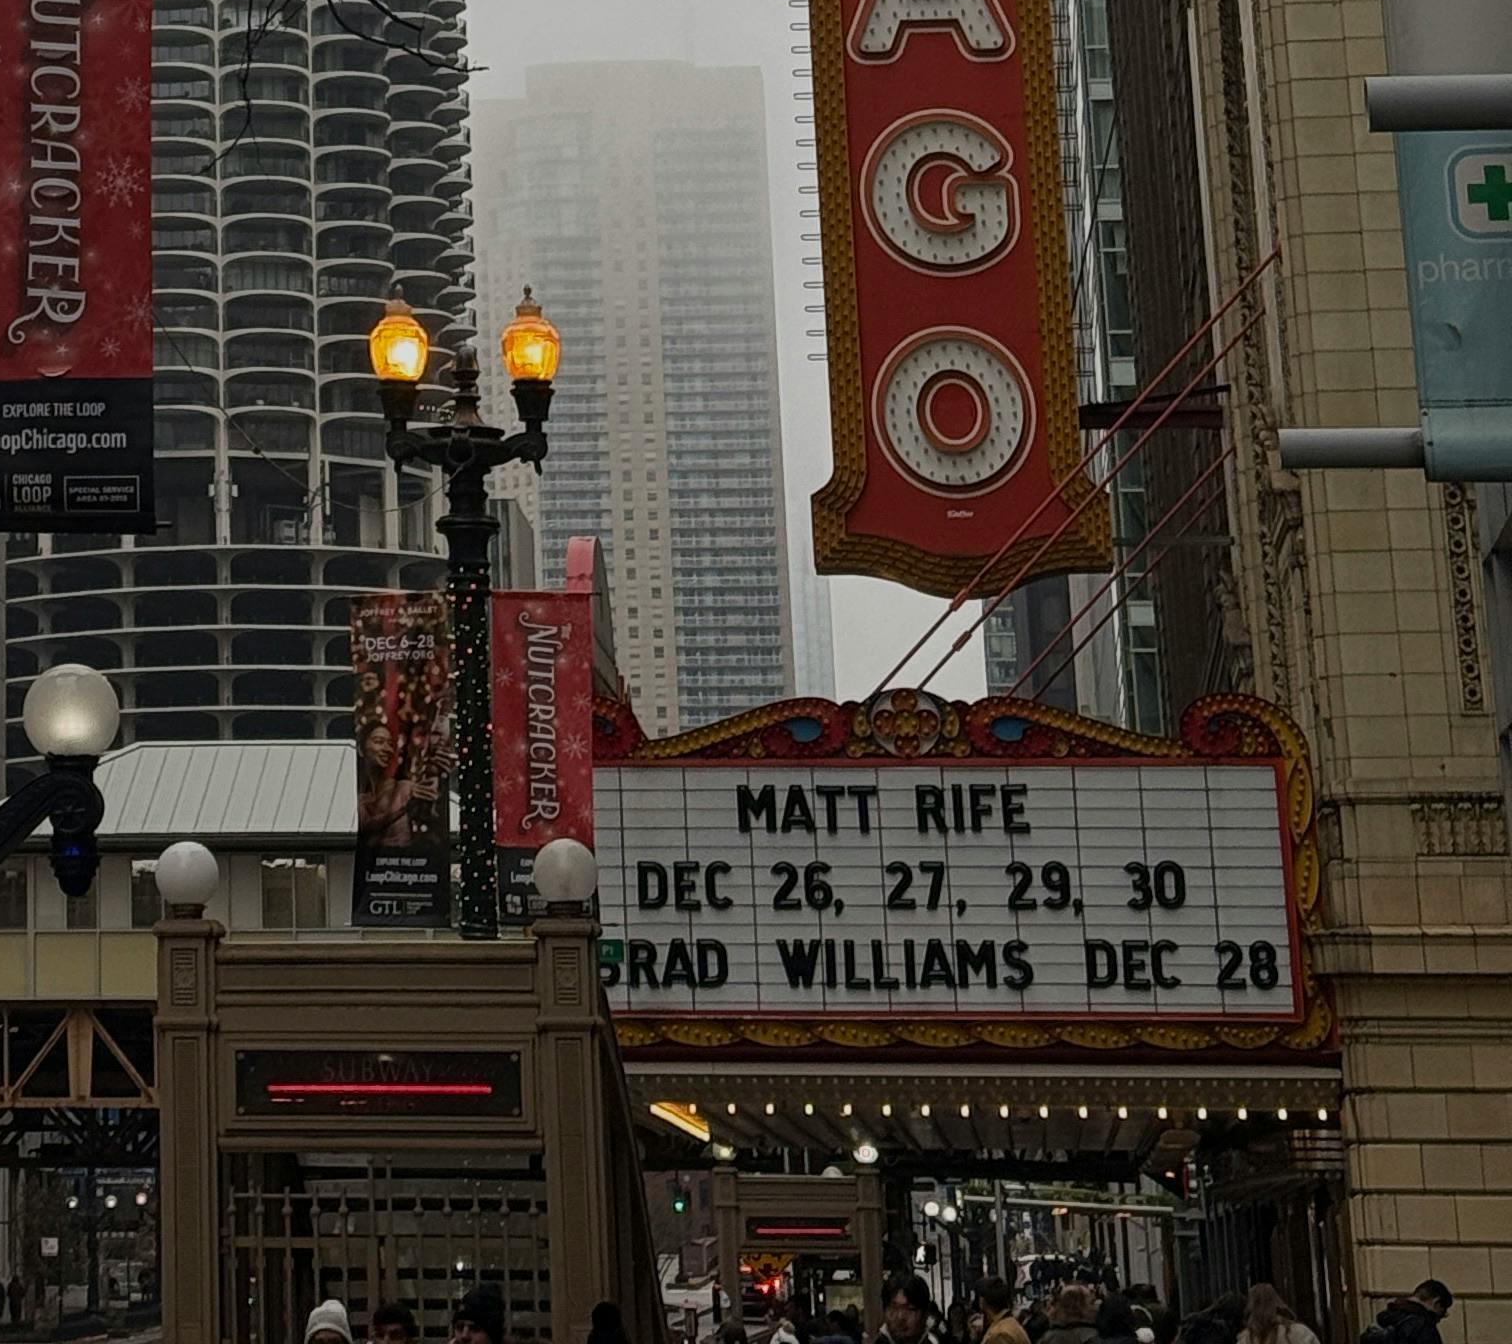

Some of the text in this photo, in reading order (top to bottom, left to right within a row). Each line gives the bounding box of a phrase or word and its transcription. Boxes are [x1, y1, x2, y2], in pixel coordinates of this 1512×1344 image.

[2, 401, 106, 418] EXPLORE THE LOOP
[12, 473, 52, 485] CHICAGO
[13, 486, 52, 504] LOOP
[366, 635, 397, 650] DEC
[518, 610, 564, 831] NUTCRACKER
[736, 782, 1032, 835] MATT RIFE
[637, 860, 1187, 917] DEC 26, 27, 29, 30
[369, 900, 403, 916] GTL
[776, 938, 1035, 990] WILLIAMS
[1085, 938, 1181, 990] DEC
[1214, 940, 1280, 990] 28
[322, 1057, 434, 1082] SUBWAY
